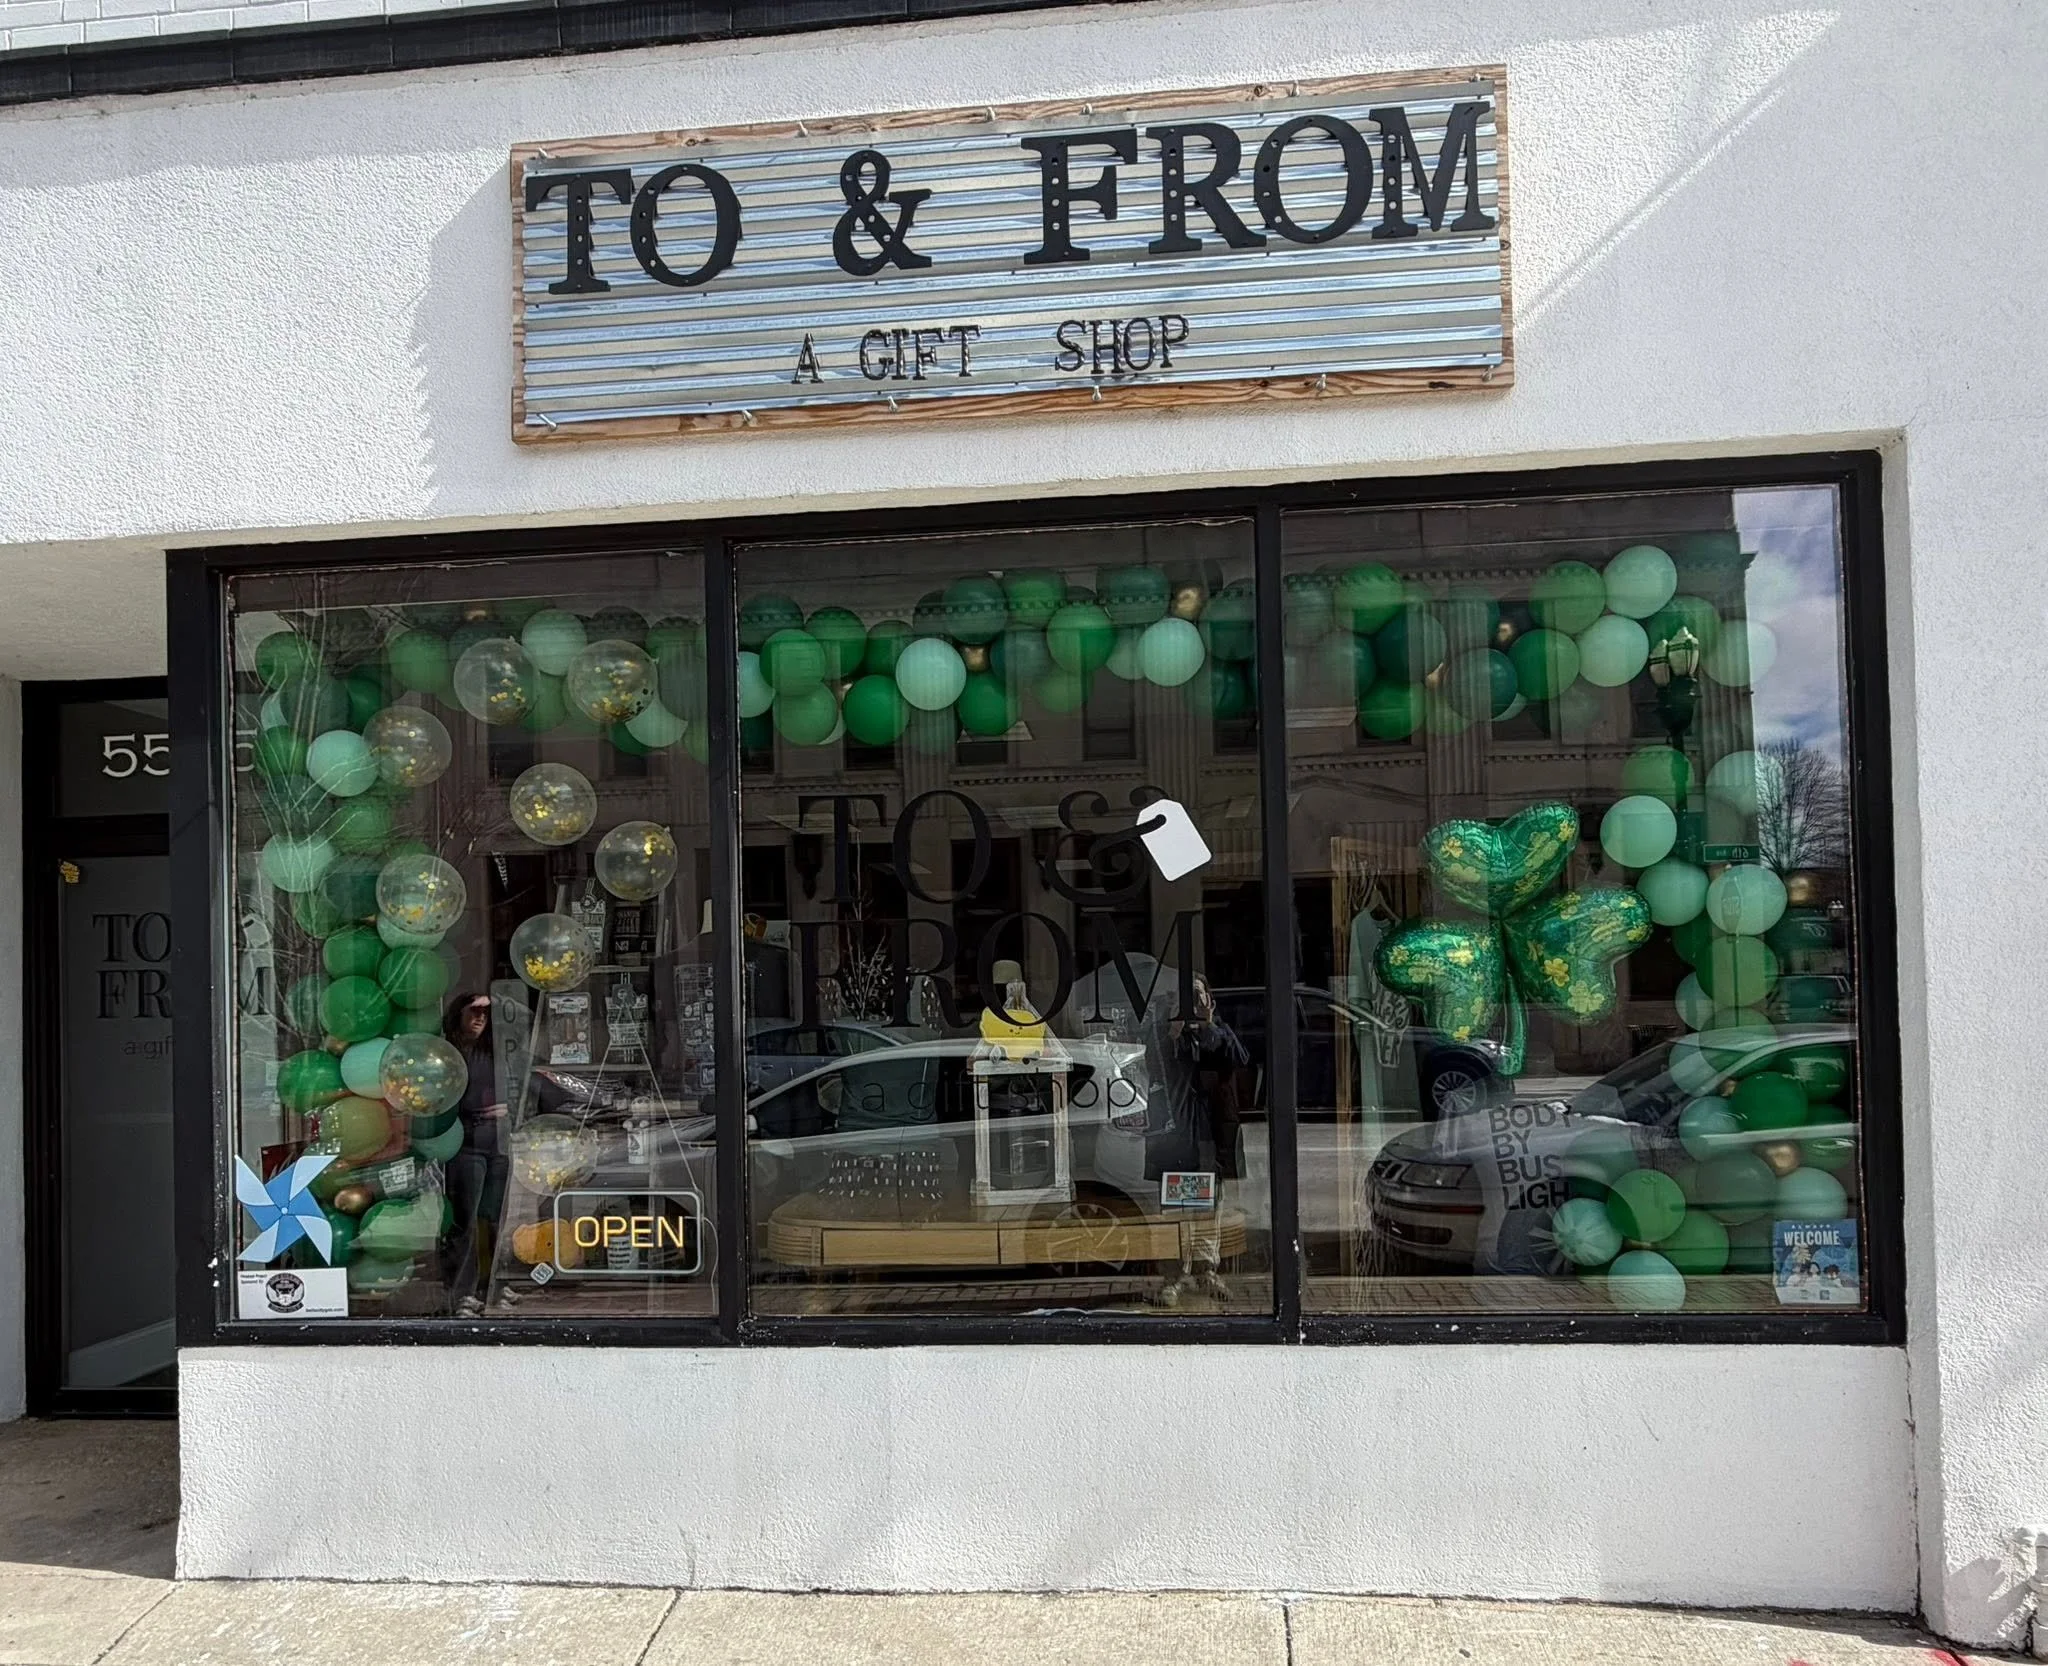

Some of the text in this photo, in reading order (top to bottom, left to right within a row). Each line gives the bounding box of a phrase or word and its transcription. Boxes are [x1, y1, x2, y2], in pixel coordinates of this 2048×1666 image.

[525, 100, 1496, 295] TO & FROM
[791, 314, 1190, 384] A GIFT SHOP
[799, 784, 1170, 905] TO &
[789, 910, 1208, 1030] FROM
[861, 1067, 1137, 1122] a gift shop
[1488, 1103, 1572, 1133] BODY
[1492, 1129, 1532, 1159] BY
[573, 1214, 685, 1250] OPEN
[1783, 1230, 1841, 1247] WELCOME
